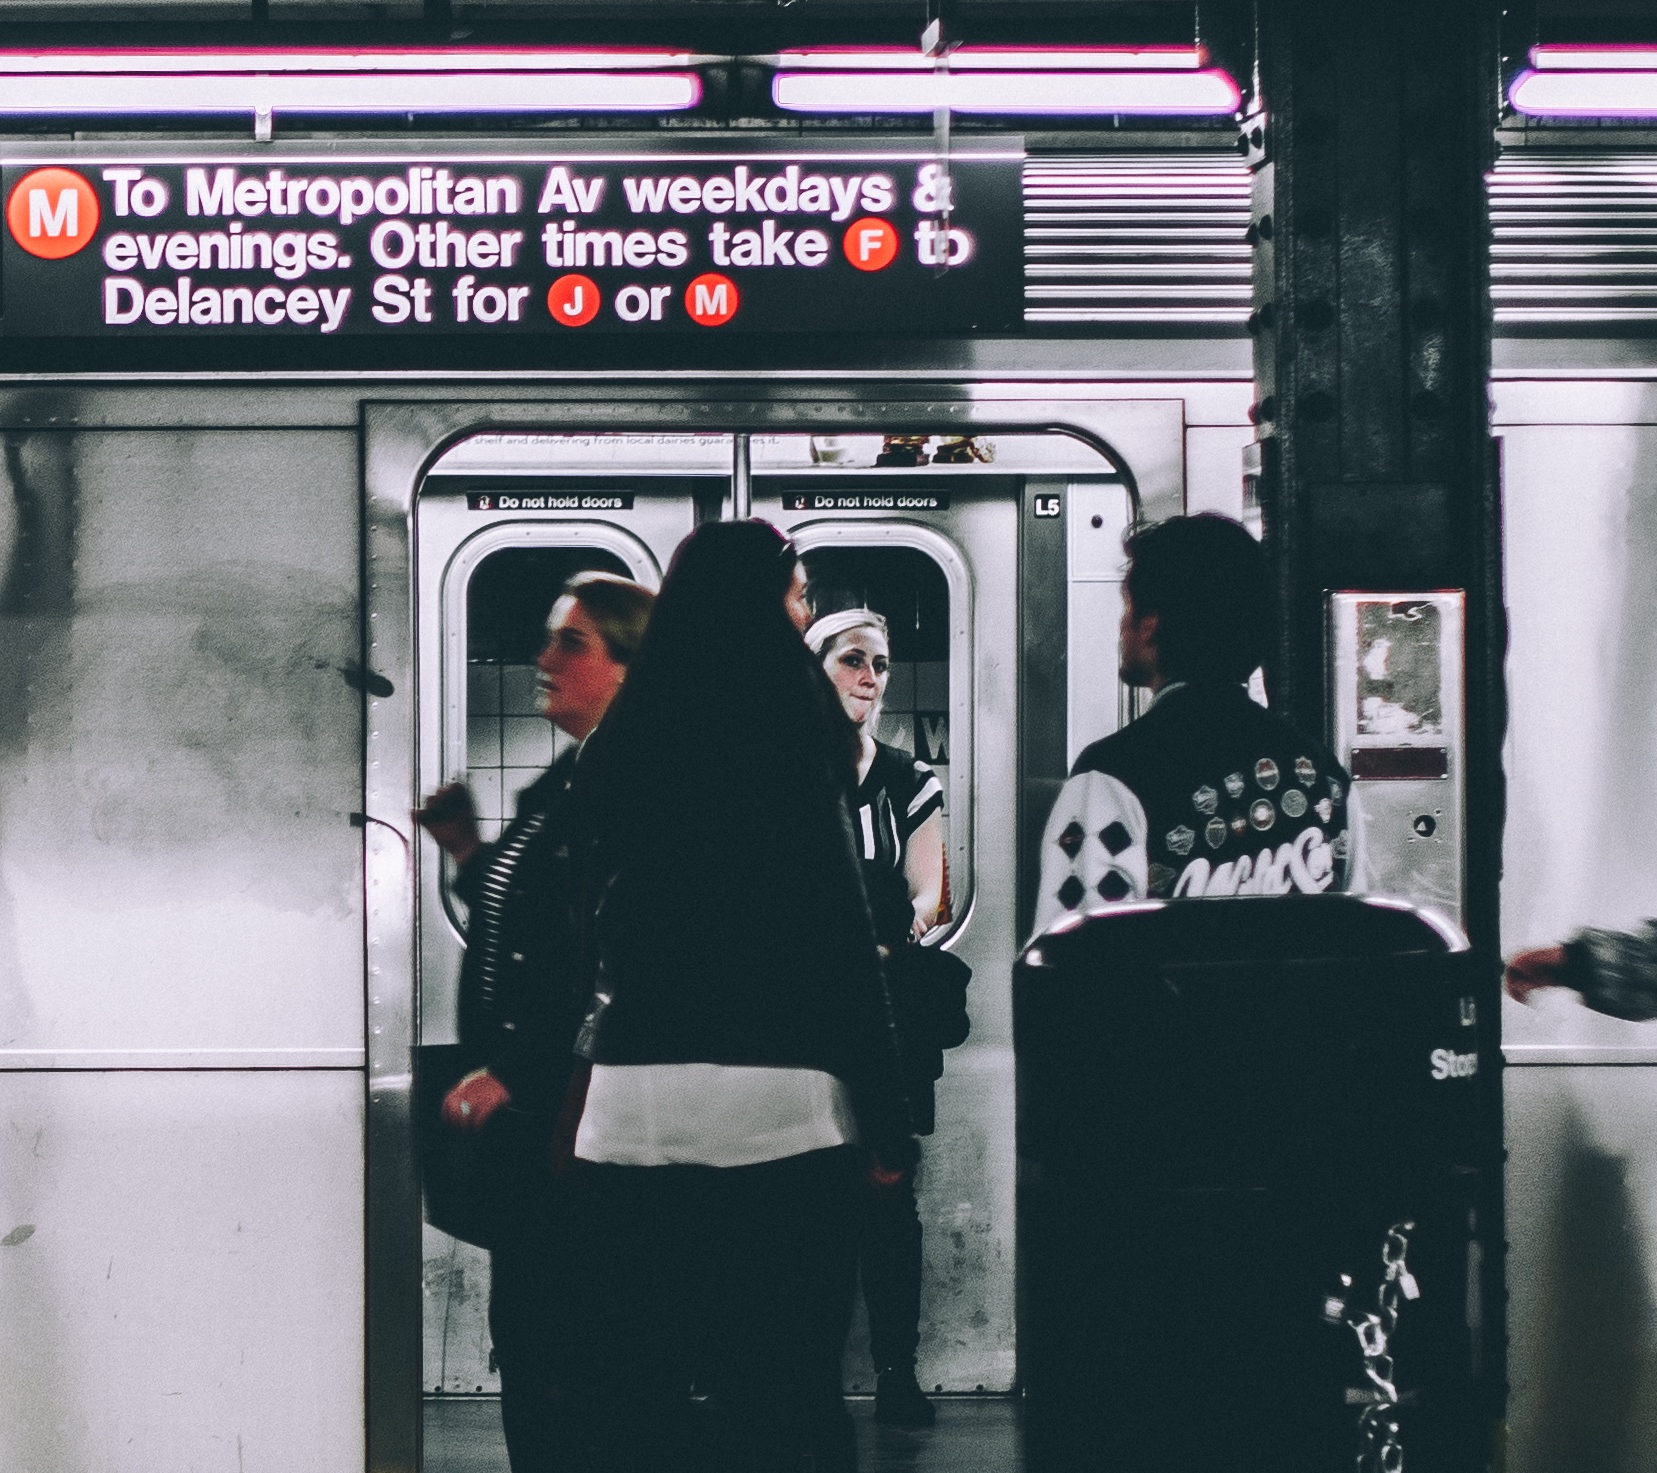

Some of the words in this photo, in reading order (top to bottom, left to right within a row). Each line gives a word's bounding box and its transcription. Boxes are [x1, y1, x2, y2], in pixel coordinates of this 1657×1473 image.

[28, 189, 79, 237] M
[103, 169, 168, 217] To
[189, 167, 519, 225] Metropolitan
[538, 166, 604, 213] Av
[623, 165, 892, 221] weekdays
[912, 164, 954, 213] &
[103, 222, 351, 279] evenings.
[373, 221, 522, 269] Other
[542, 221, 688, 267] times
[709, 220, 828, 266] take
[860, 230, 884, 261] F
[914, 221, 974, 266] to
[104, 277, 351, 332] Delancey
[372, 275, 433, 324] St
[453, 276, 529, 322] for
[563, 286, 584, 316] J
[615, 285, 671, 321] or
[694, 284, 728, 315] M
[506, 435, 528, 445] and
[593, 434, 623, 445] from
[626, 434, 654, 445] local
[498, 495, 519, 508] Do
[522, 496, 545, 508] not
[548, 495, 578, 508] hold
[581, 495, 623, 509] doors
[814, 495, 834, 508] Do
[837, 495, 860, 508] not
[863, 495, 894, 508] hold
[897, 495, 938, 508] doors
[1035, 498, 1060, 516] L5
